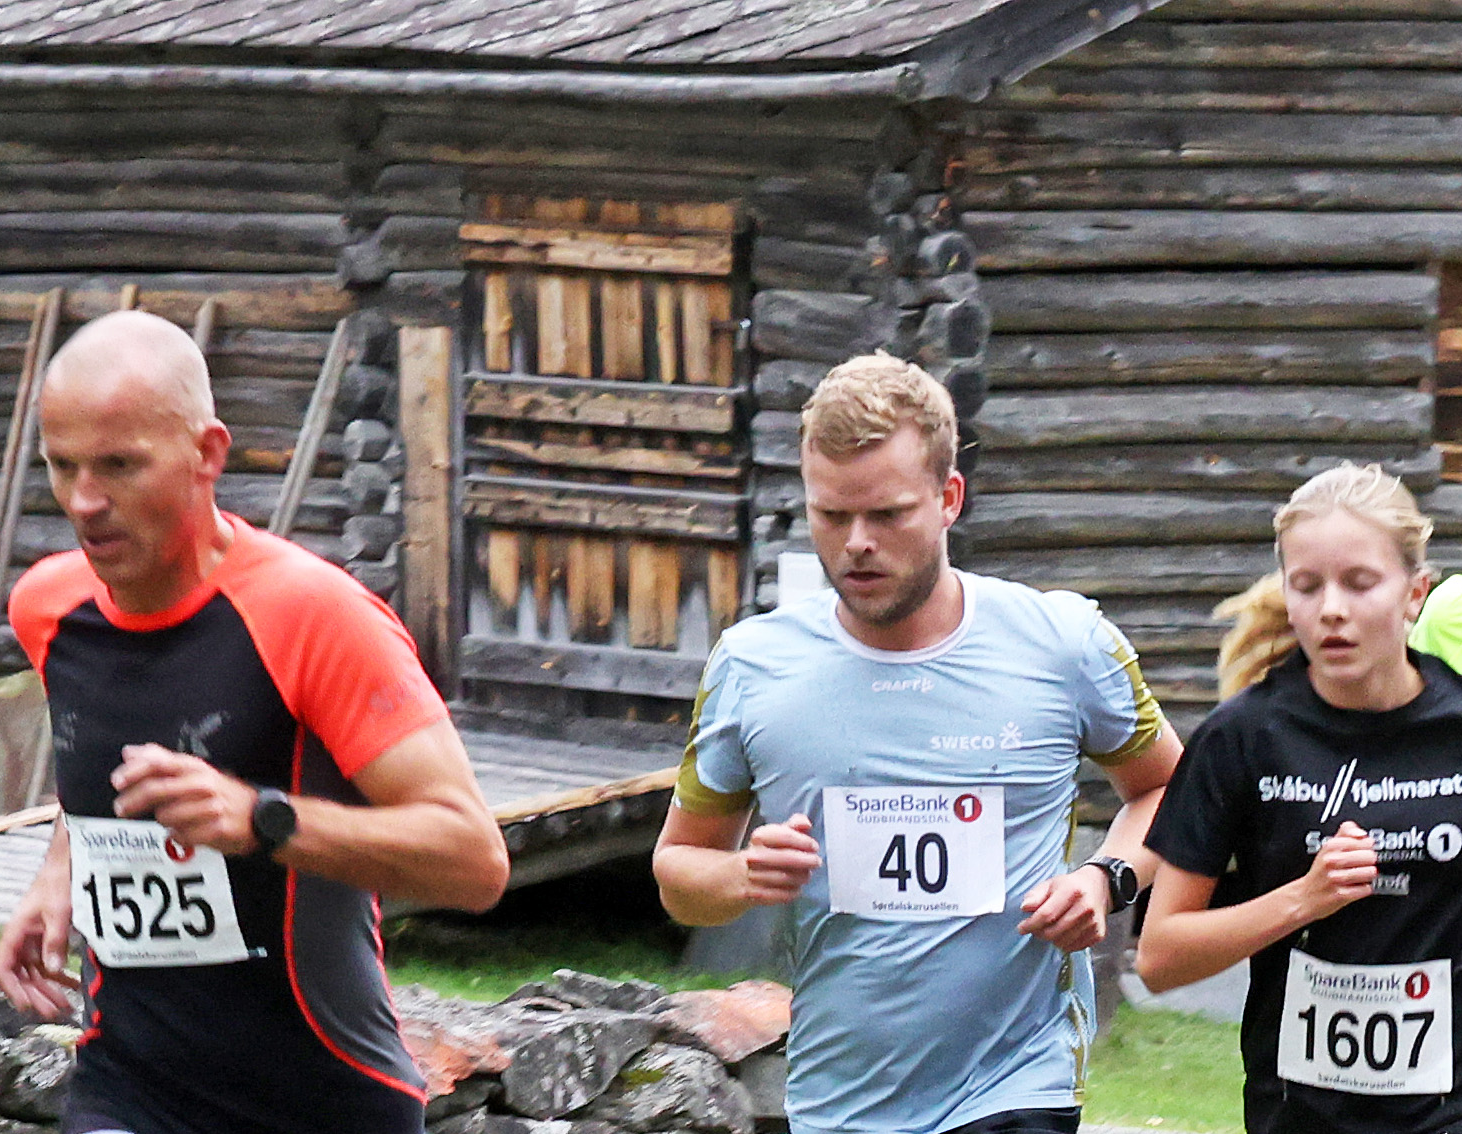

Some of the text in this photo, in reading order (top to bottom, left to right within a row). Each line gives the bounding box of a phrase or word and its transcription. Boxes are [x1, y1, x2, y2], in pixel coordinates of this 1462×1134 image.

[871, 679, 917, 693] CRAFT
[930, 735, 995, 750] SWECO
[845, 793, 950, 814] SpareBank
[878, 832, 949, 894] 40
[82, 872, 215, 940] 1525
[1297, 1003, 1435, 1071] 1607
